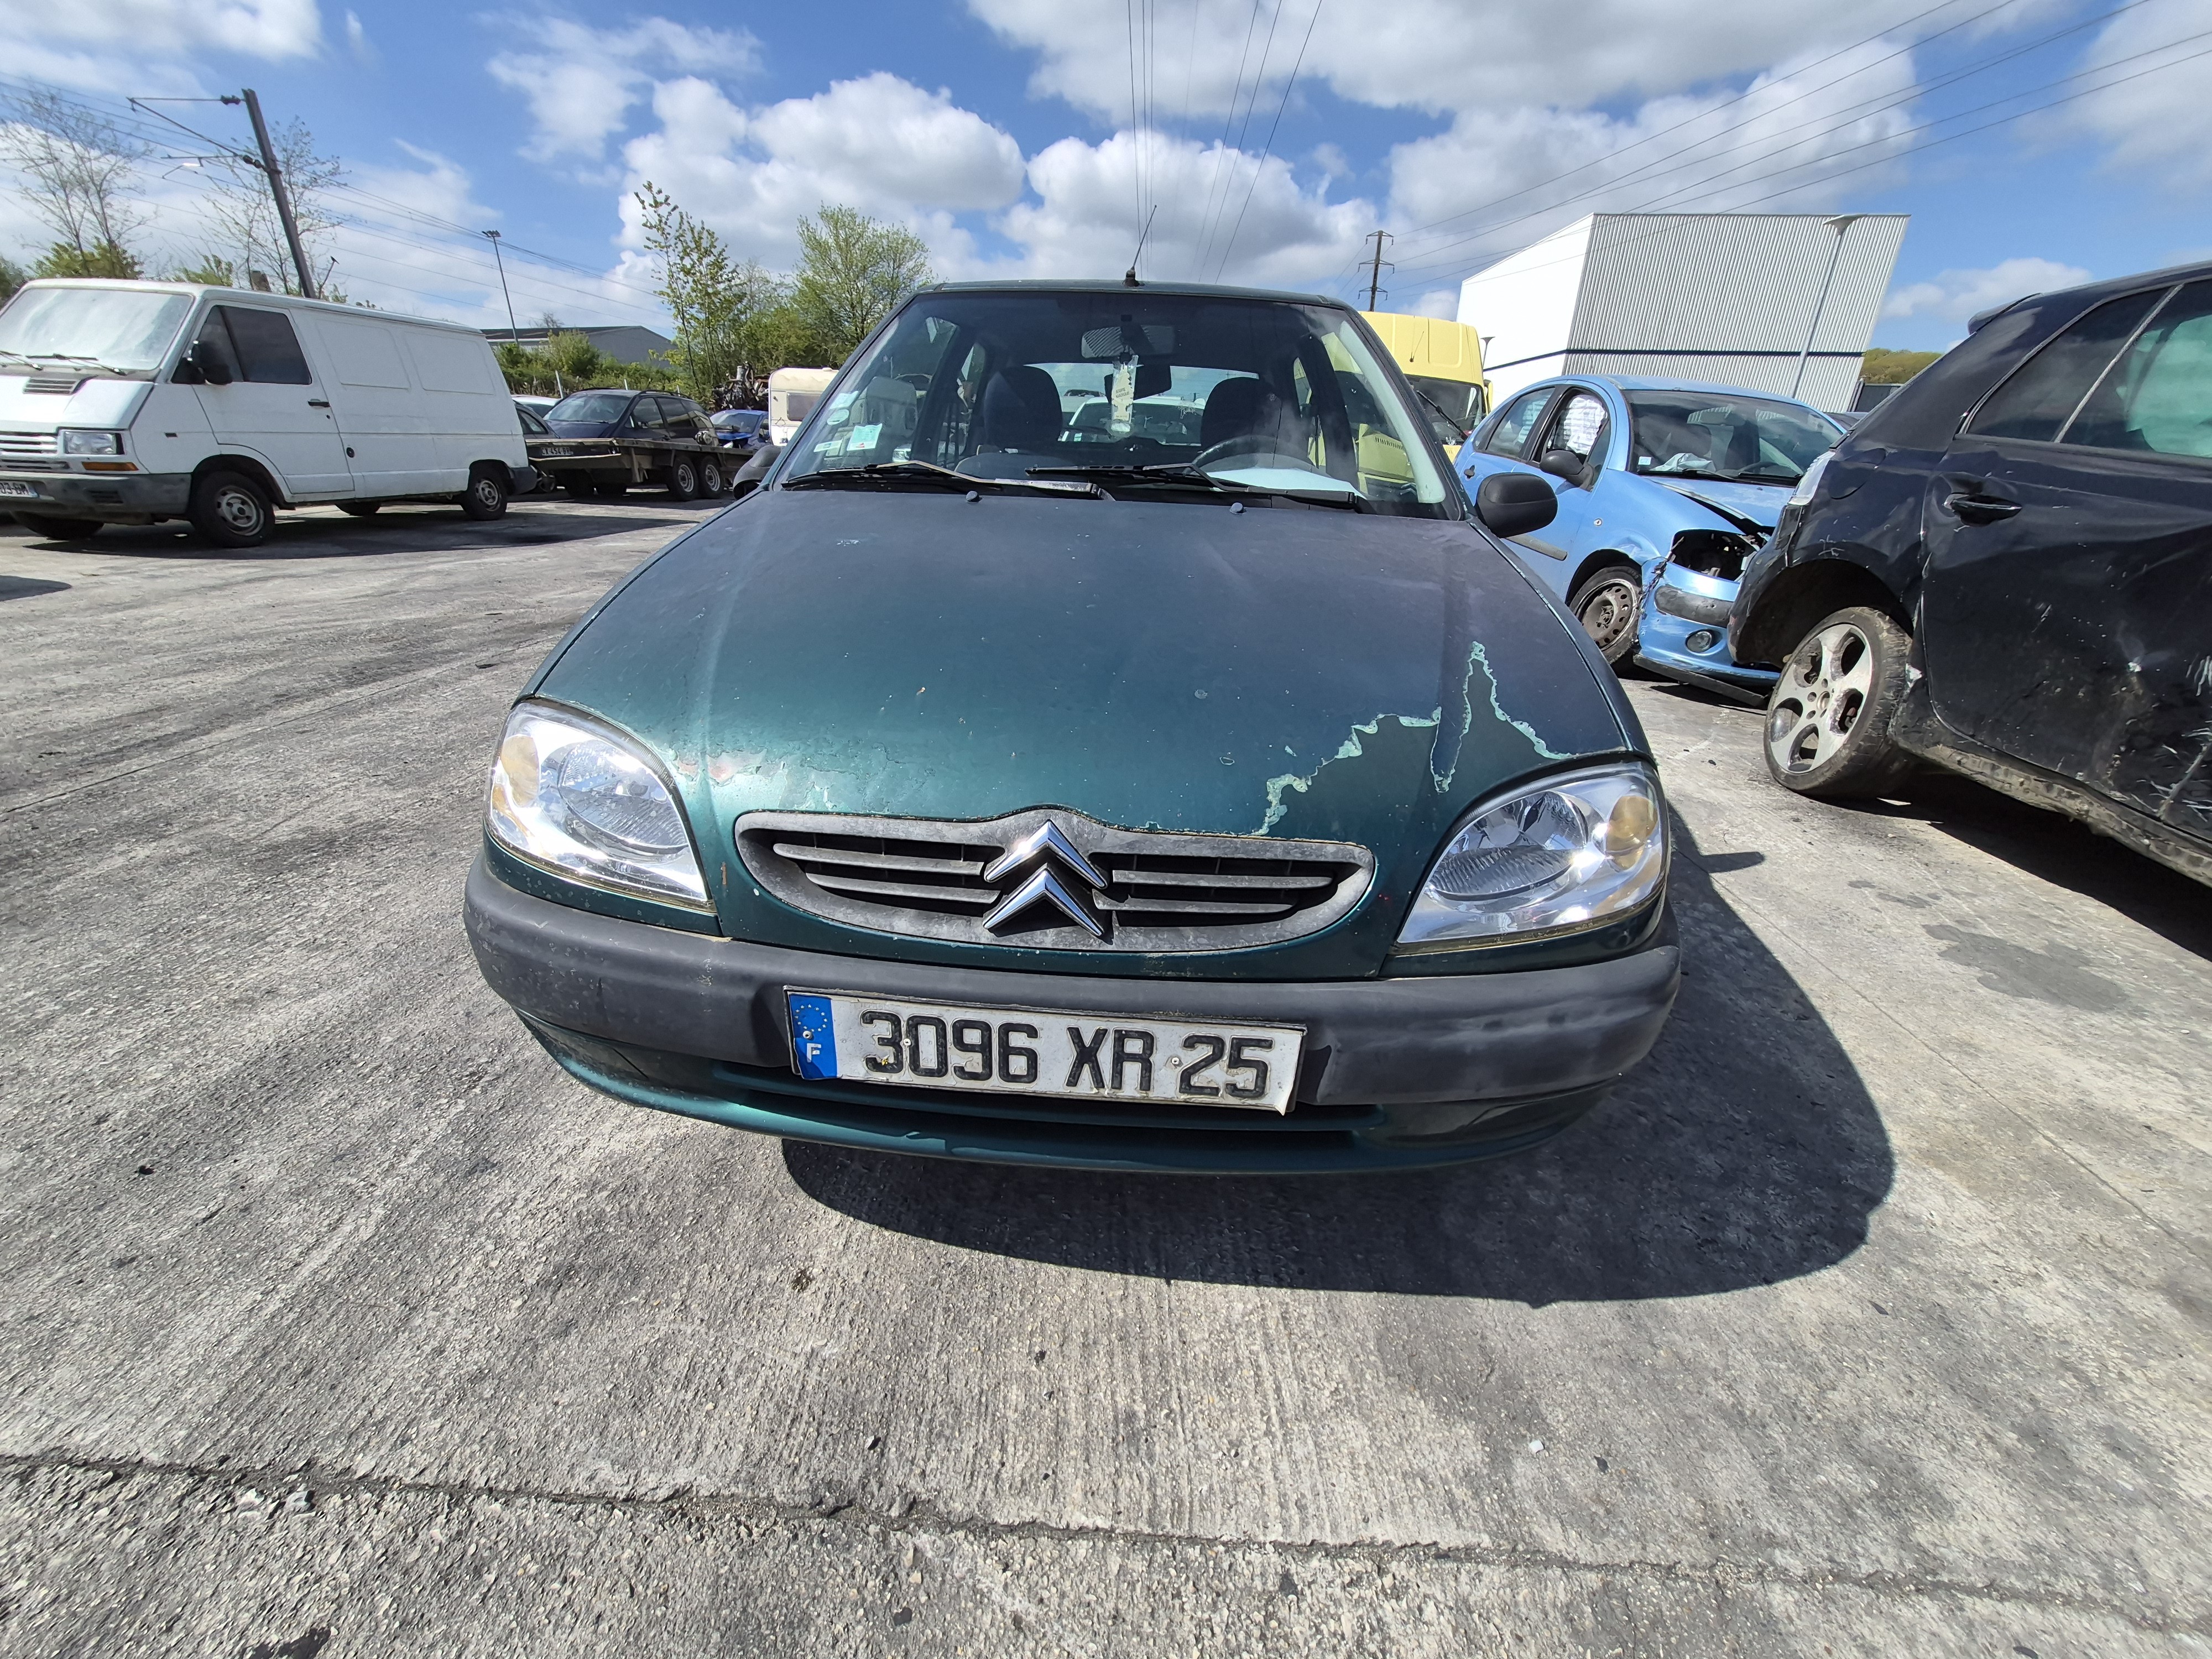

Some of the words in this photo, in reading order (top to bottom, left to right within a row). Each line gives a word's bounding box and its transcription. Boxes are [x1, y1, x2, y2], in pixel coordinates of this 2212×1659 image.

[806, 1042, 822, 1063] F
[860, 1010, 1039, 1084] 3096
[1066, 1026, 1155, 1092] XR
[1179, 1034, 1273, 1098] 25
